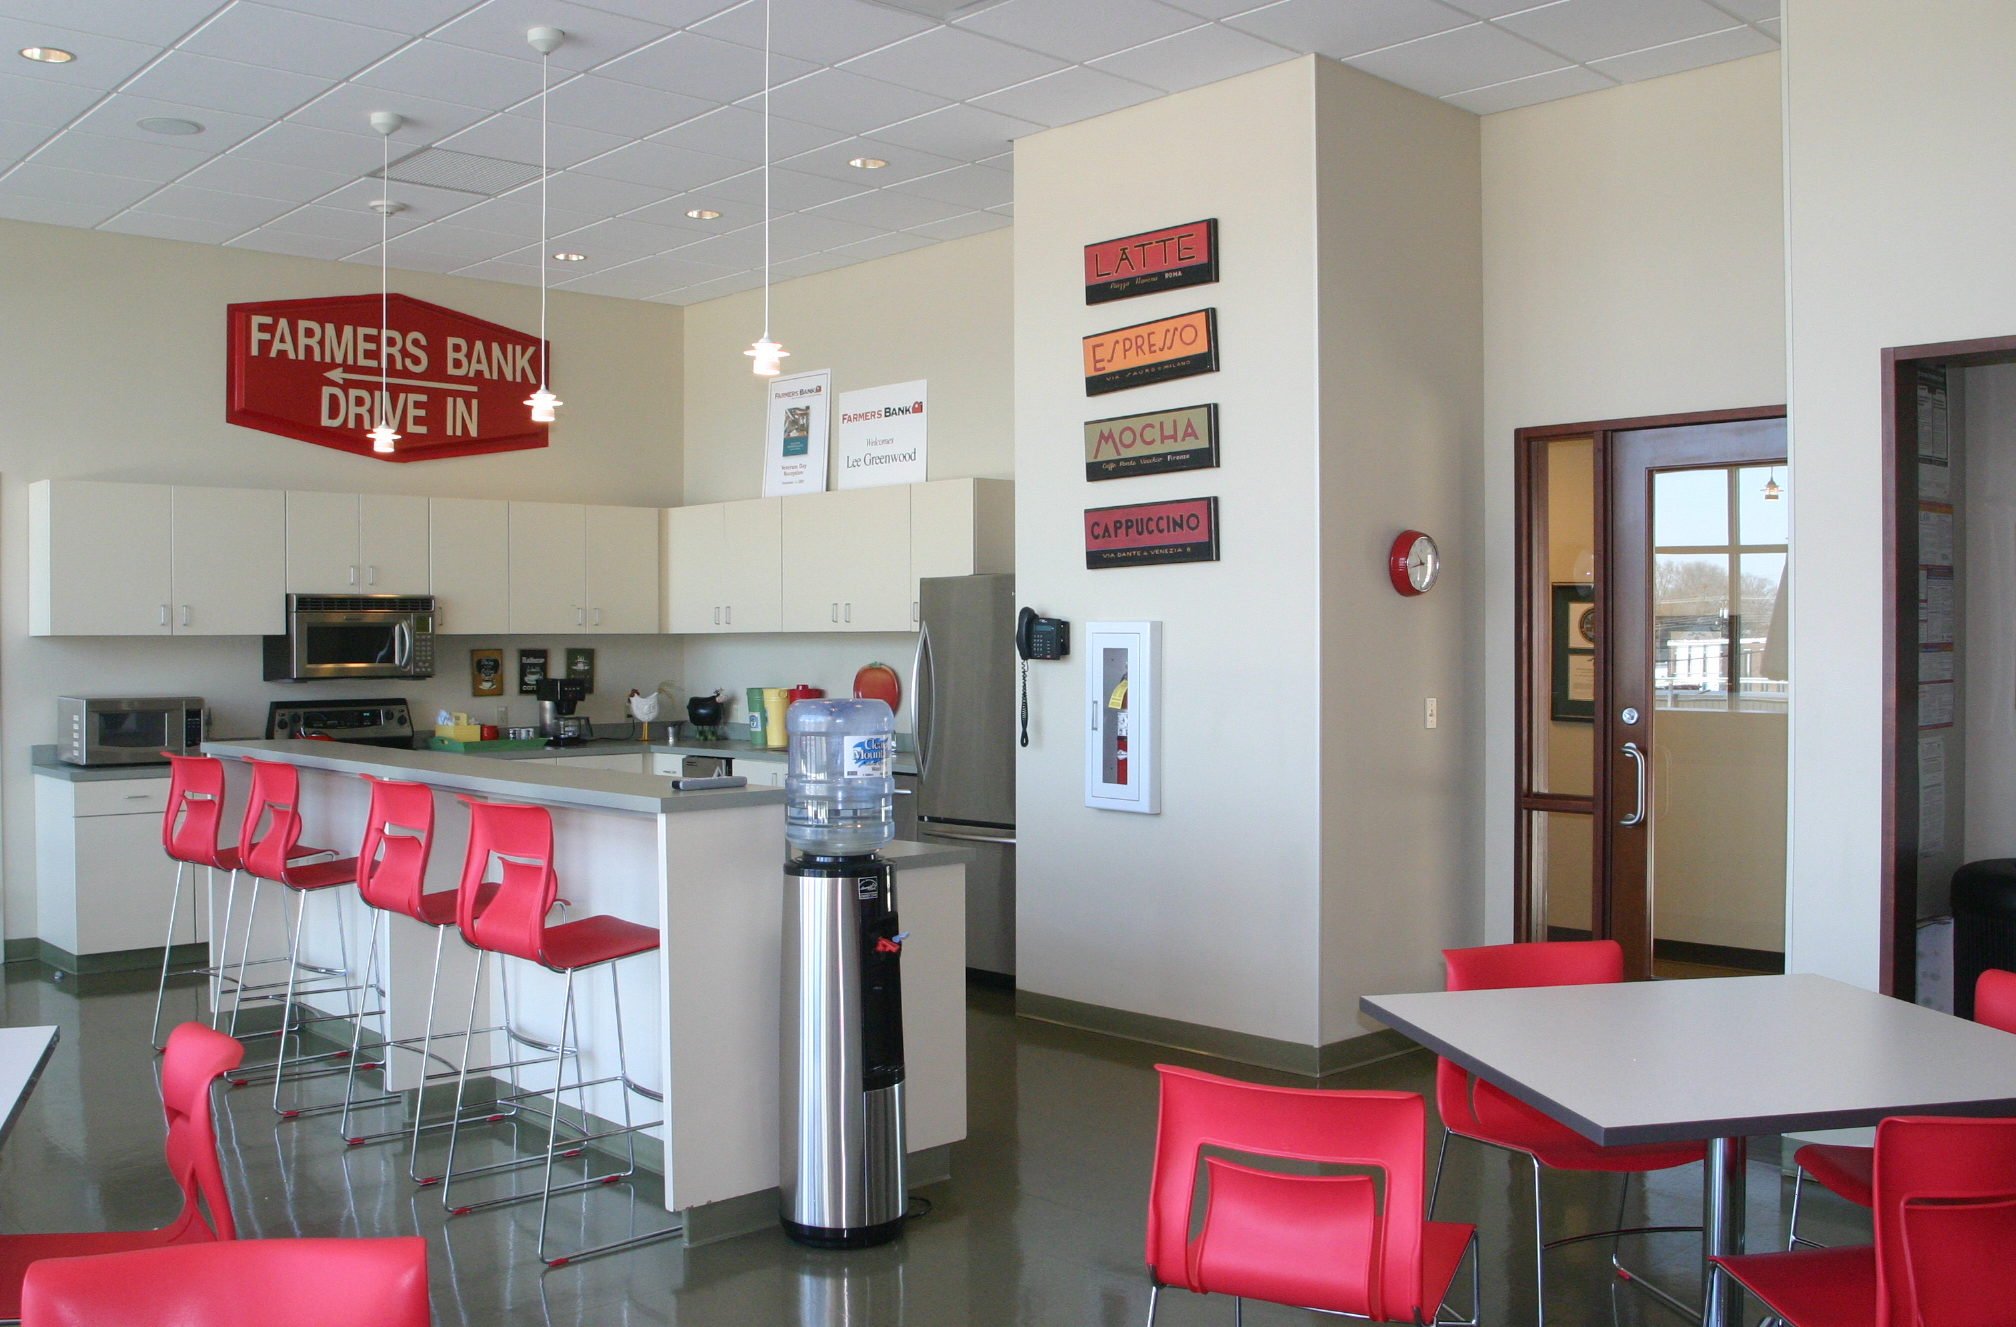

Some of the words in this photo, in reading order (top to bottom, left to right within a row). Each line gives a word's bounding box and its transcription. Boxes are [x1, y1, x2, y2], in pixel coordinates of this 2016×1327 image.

[1095, 233, 1195, 278] LATTE
[1165, 271, 1182, 279] ROMA
[251, 315, 428, 373] FARMERS
[447, 337, 537, 384] BANK
[1092, 324, 1198, 372] ESPRESSO
[775, 390, 799, 399] FARMERS
[800, 388, 816, 396] BANK
[321, 386, 427, 434] DRIVE
[446, 397, 478, 438] IN
[842, 409, 883, 425] FARMERS
[884, 403, 912, 418] BANK
[1093, 417, 1200, 460] MOCHA
[846, 455, 862, 469] Lee
[864, 447, 917, 466] Greenwood
[1091, 513, 1200, 540] CAPPUCCINO
[1117, 550, 1141, 558] DANTE
[1150, 547, 1183, 555] VENEZIA
